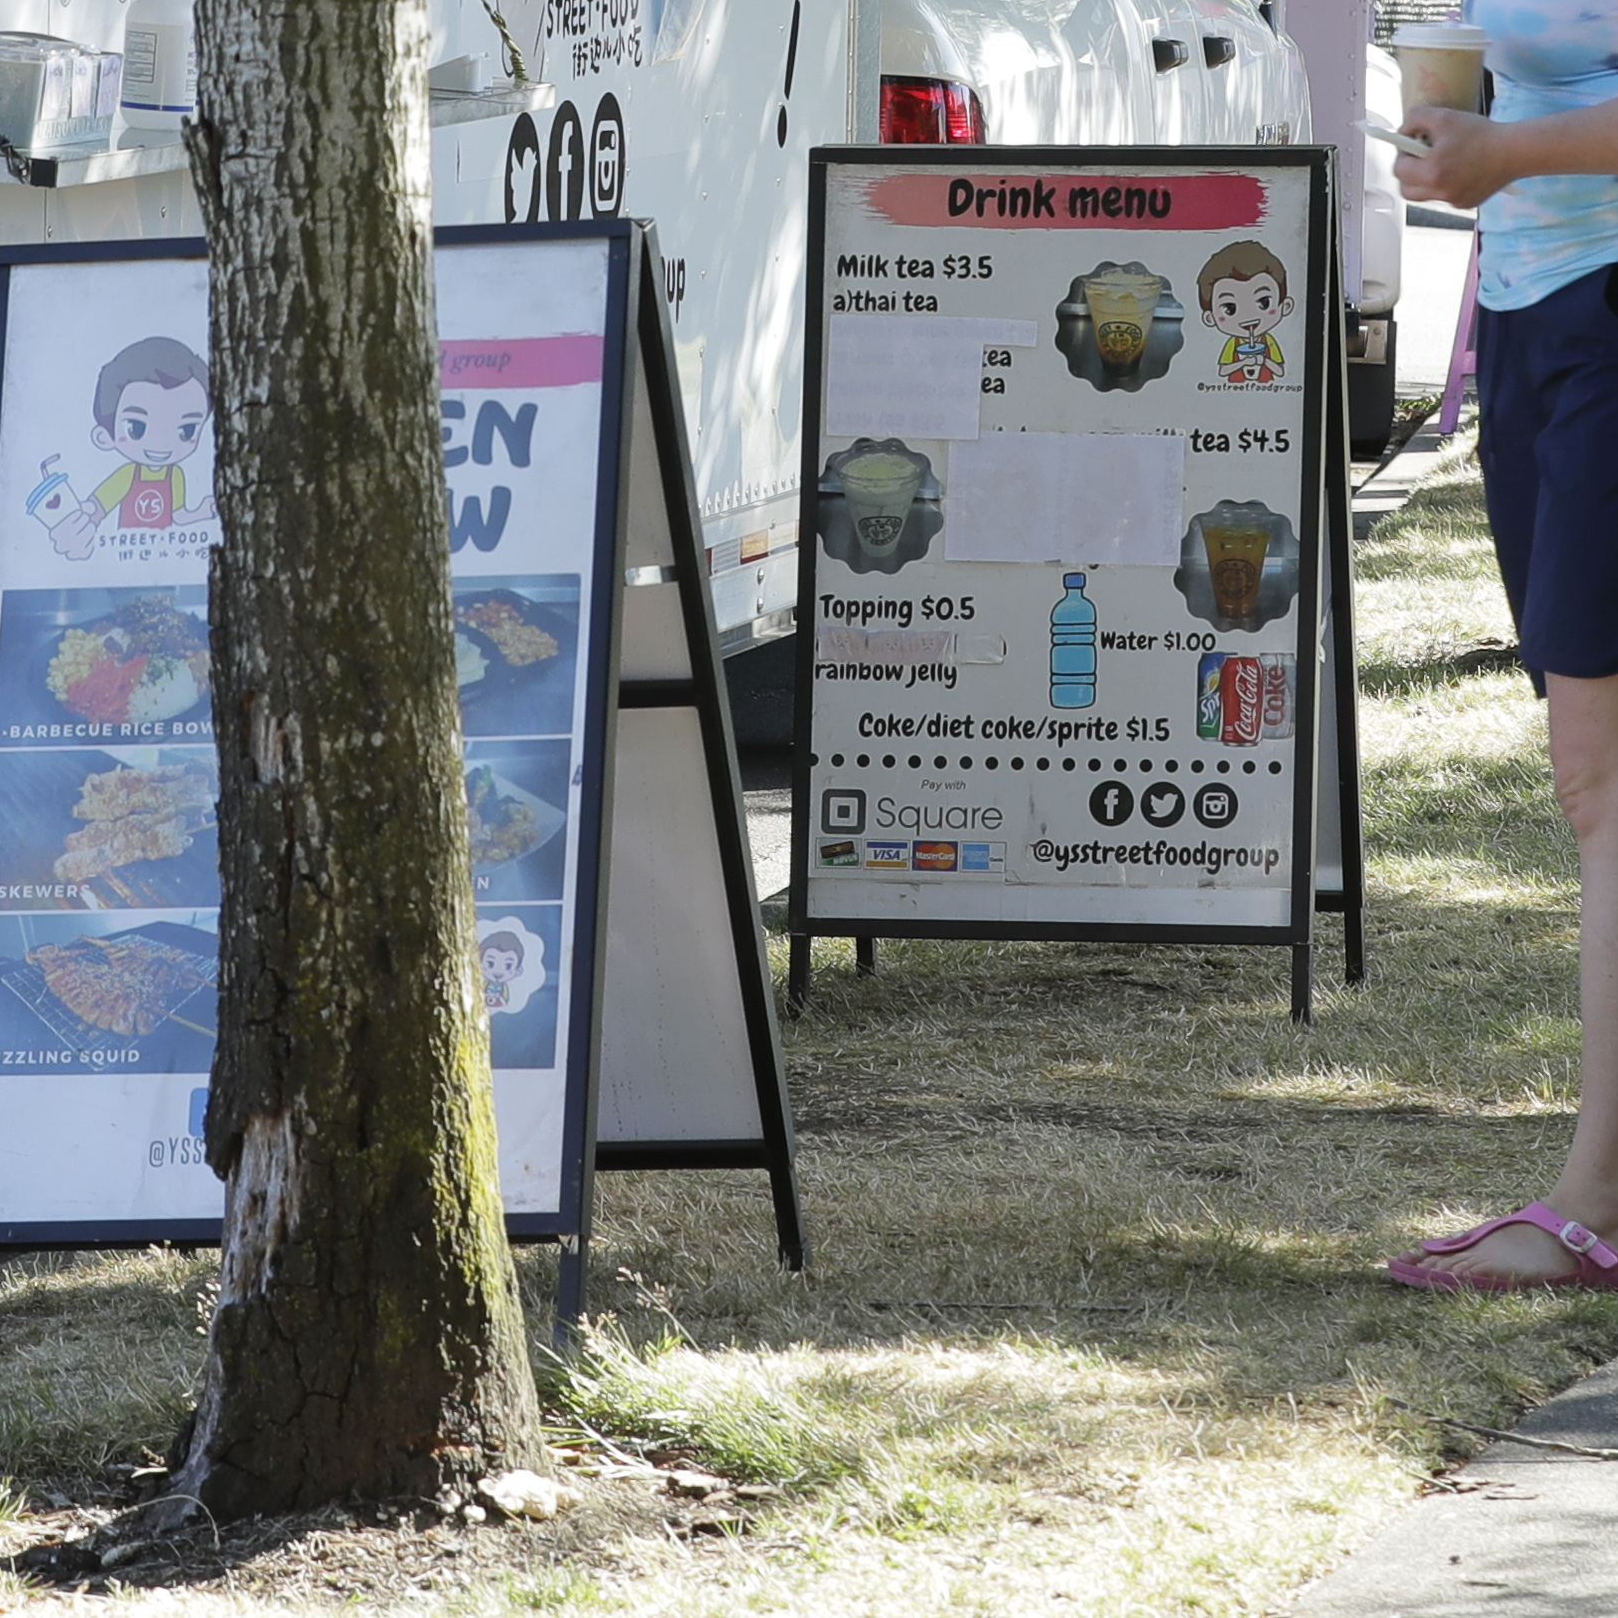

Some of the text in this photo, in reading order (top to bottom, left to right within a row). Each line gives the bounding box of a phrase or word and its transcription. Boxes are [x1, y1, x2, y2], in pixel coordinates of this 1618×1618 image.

[947, 178, 1172, 219] Drink menu
[837, 254, 993, 280] Milk tea $3.5
[833, 289, 938, 313] a)thai tea
[450, 350, 512, 374] group
[981, 376, 1006, 395] ea
[1197, 382, 1303, 394] @ysstreetfoodgroup
[1190, 428, 1291, 454] tea $4.5
[139, 498, 161, 515] YS
[819, 594, 975, 628] Topping $0.5
[1100, 632, 1217, 652] Water $1.00
[815, 663, 904, 682] rainbow
[1201, 691, 1221, 724] Spr
[1264, 665, 1286, 726] Coke
[10, 721, 214, 738] BARBECUE RICE BOW
[858, 712, 1170, 748] Coke/diet coke/sprite $1.5
[920, 780, 966, 792] Pay with
[875, 797, 1003, 836] Square
[873, 849, 901, 861] VISA
[915, 851, 956, 862] MasterCard
[1032, 839, 1280, 876] @ysstreetfoodgroup
[79, 1049, 140, 1064] SQUID
